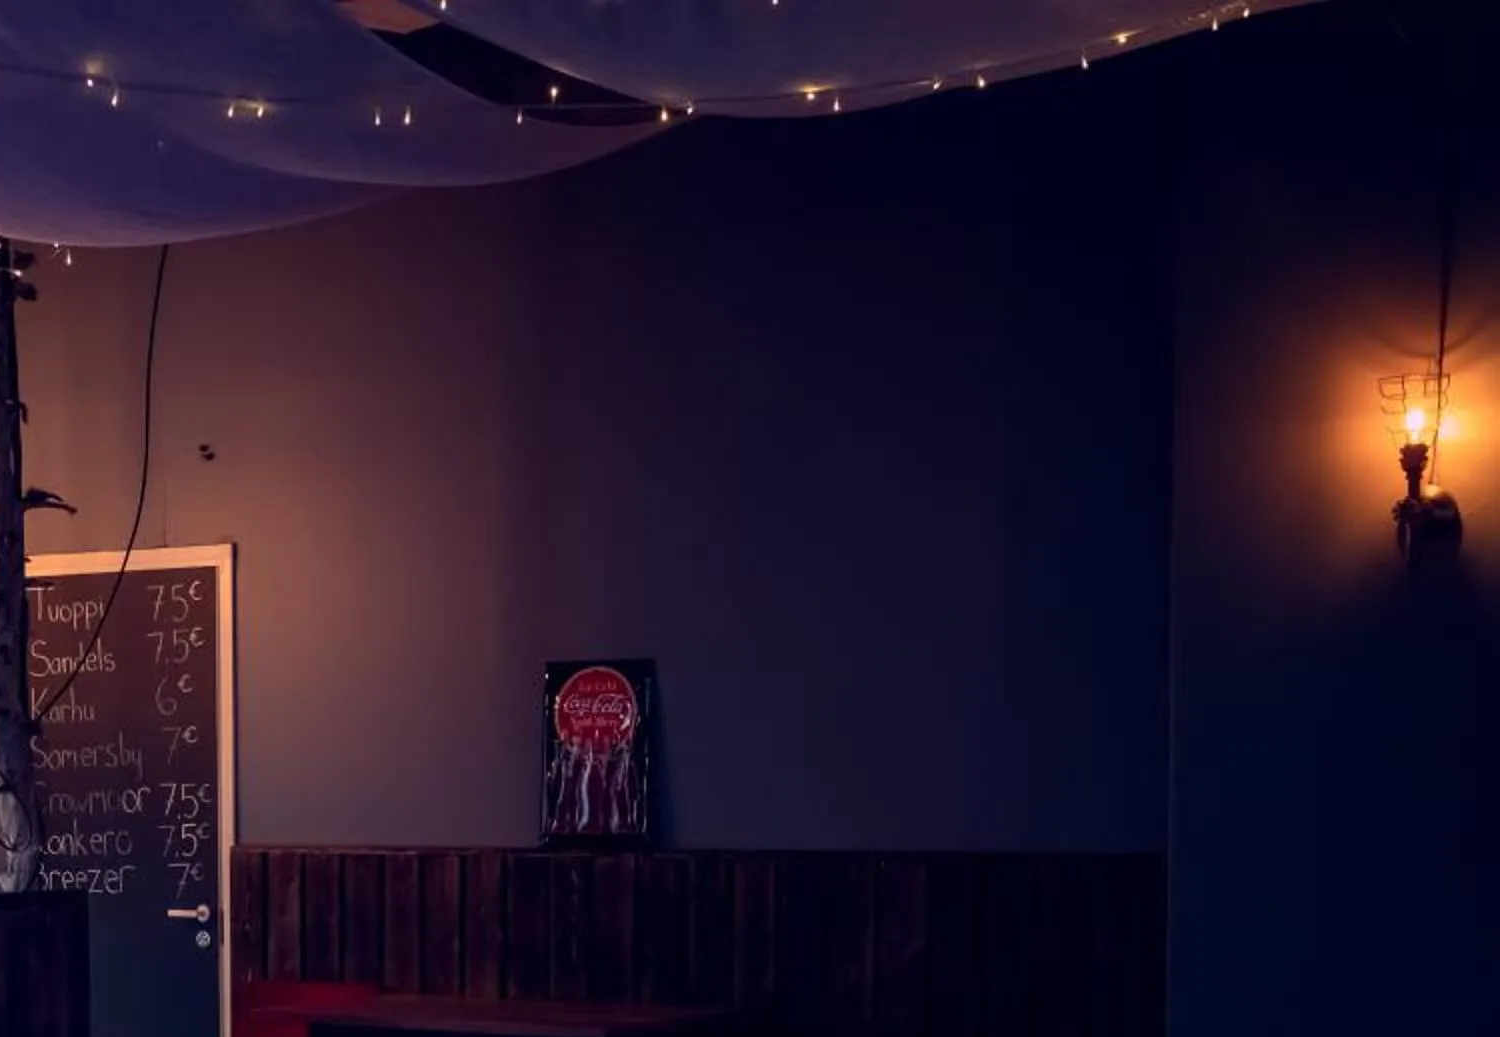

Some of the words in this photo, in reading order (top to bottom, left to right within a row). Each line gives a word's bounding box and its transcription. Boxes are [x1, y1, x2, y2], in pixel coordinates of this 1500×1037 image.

[25, 586, 105, 631] Tuoppi
[29, 637, 116, 677] Sandels
[31, 685, 95, 723] Karhu
[155, 673, 194, 715] 6€
[30, 728, 143, 782] Somersby
[161, 725, 199, 766] 7€
[40, 817, 132, 856] onkero
[166, 862, 204, 900] 7€
